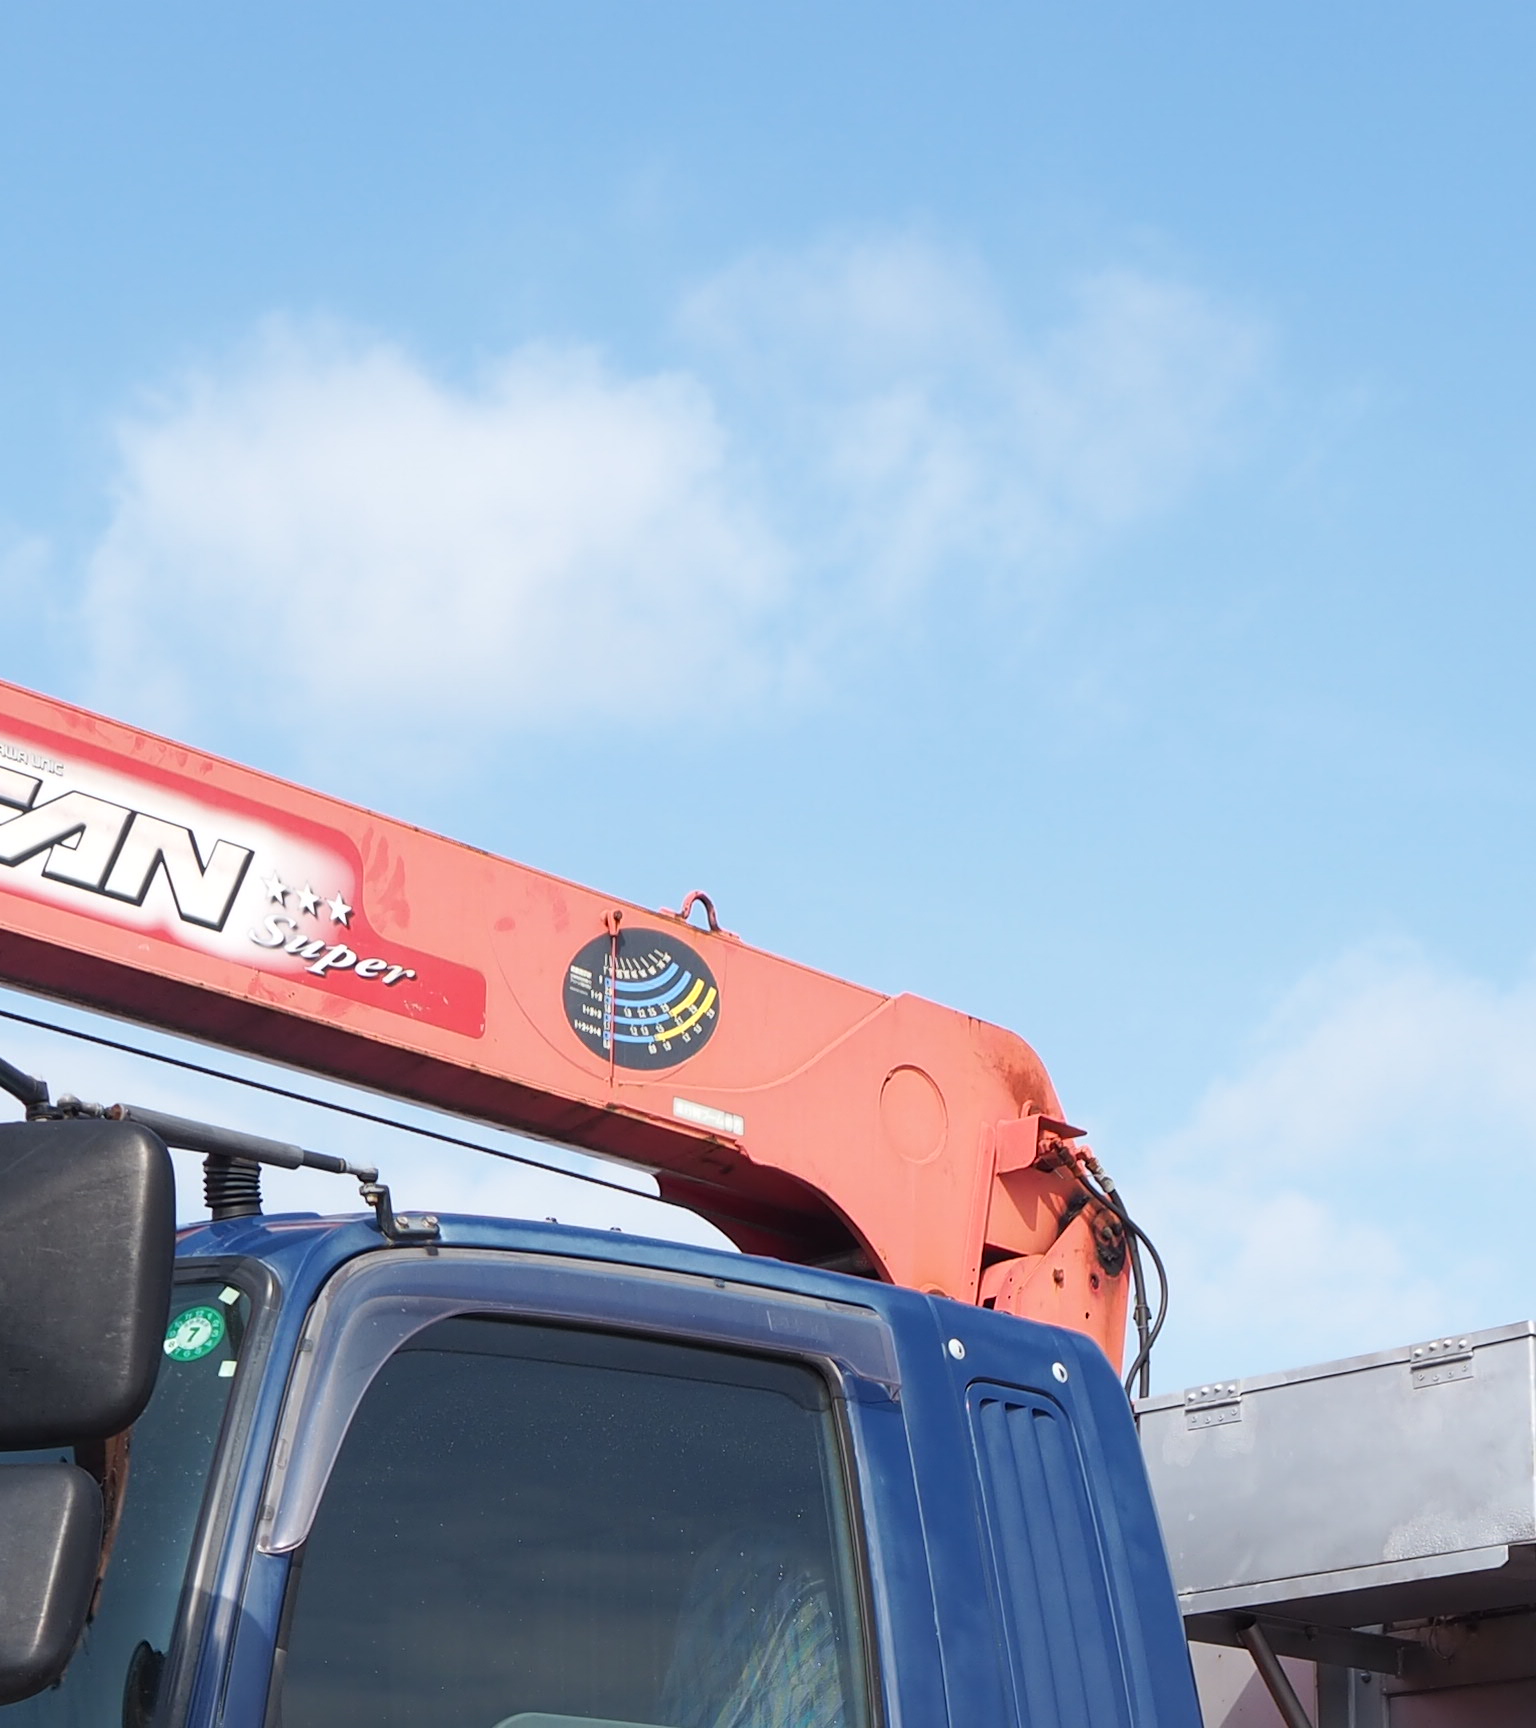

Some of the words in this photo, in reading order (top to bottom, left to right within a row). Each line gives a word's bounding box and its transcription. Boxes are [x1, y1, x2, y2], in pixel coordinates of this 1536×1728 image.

[31, 753, 64, 777] UNIC
[249, 914, 417, 988] Super
[187, 1326, 201, 1342] 7
